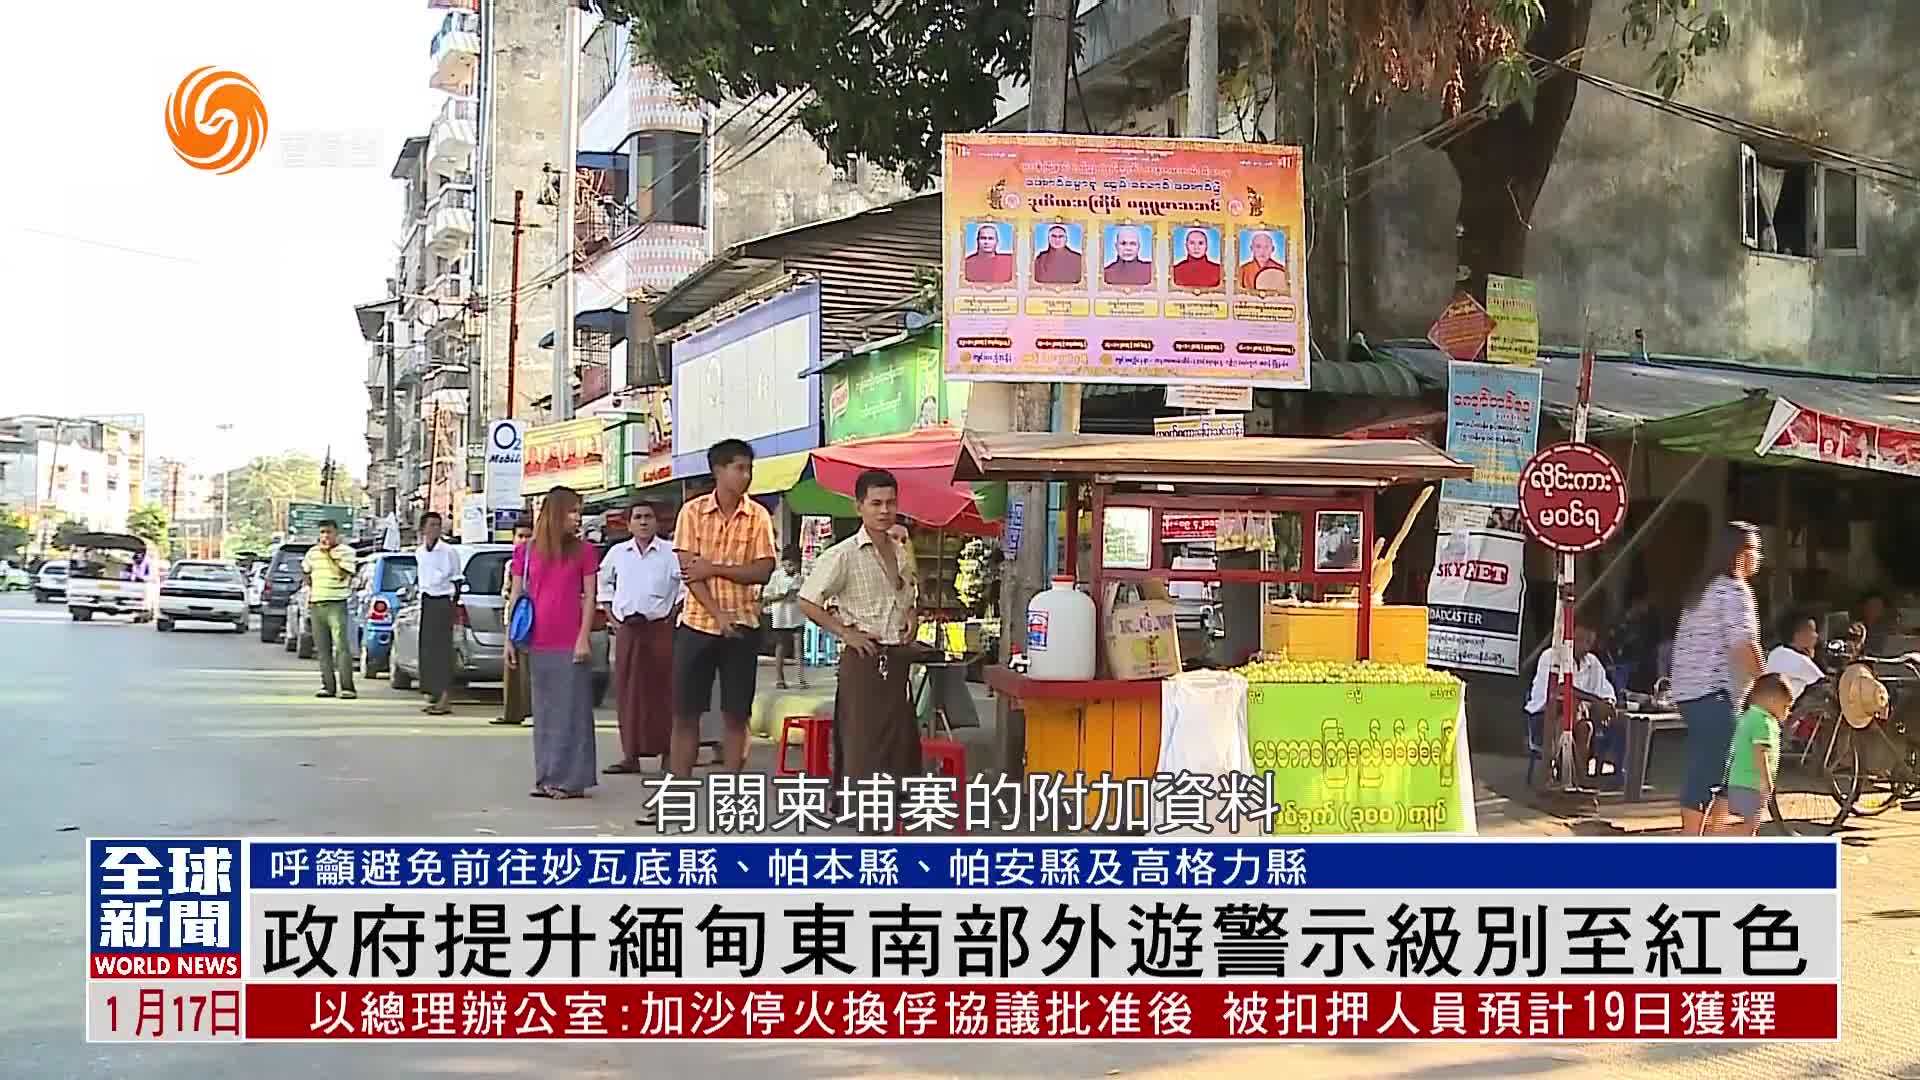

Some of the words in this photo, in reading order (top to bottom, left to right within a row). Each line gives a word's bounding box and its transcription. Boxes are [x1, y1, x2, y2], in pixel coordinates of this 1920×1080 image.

[489, 454, 522, 463] Mobil
[1530, 462, 1612, 497] လိုင်းကား
[1539, 499, 1601, 534] မဝင်ရ
[1437, 562, 1507, 583] SKYNET
